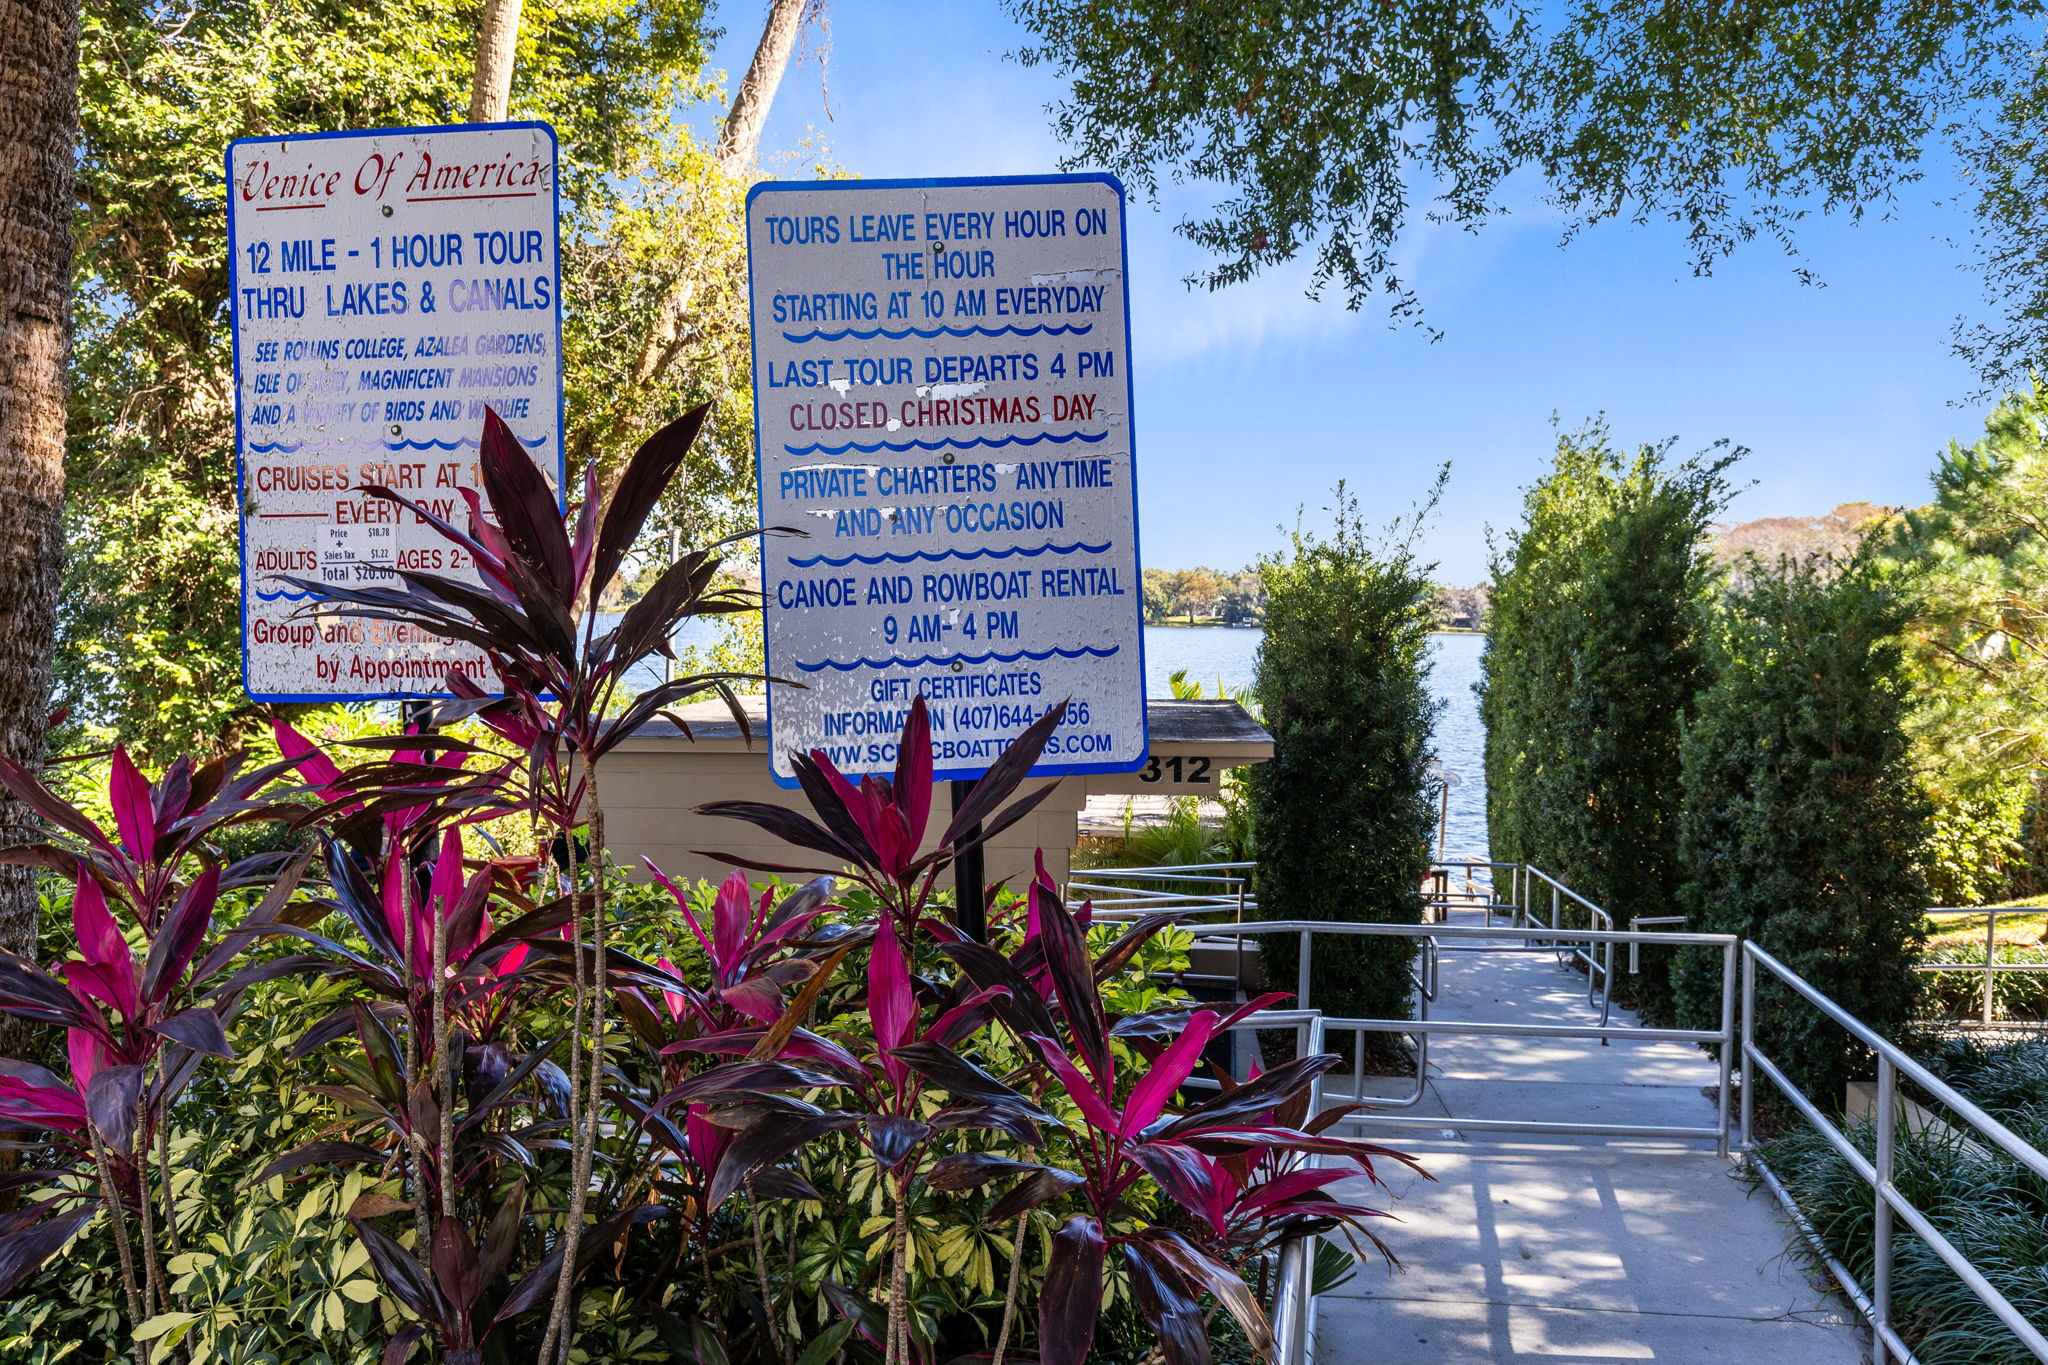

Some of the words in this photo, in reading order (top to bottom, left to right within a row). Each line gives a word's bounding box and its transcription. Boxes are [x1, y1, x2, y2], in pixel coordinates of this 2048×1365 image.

[242, 161, 340, 201] Venice
[354, 152, 403, 200] Of
[406, 152, 541, 193] America
[765, 215, 840, 245] TOURS
[850, 214, 915, 242] LEAVE
[926, 212, 995, 240] EVERY
[1005, 210, 1065, 239] HOUR
[1075, 208, 1107, 236] ON
[246, 242, 271, 274] 12
[281, 239, 336, 272] MILE
[371, 237, 381, 268] 1
[392, 234, 462, 267] HOUR
[474, 231, 543, 264] TOUR
[882, 253, 924, 280] THE
[934, 250, 996, 279] HOUR
[242, 286, 305, 319] THRU
[327, 282, 407, 316] LAKES
[420, 281, 436, 313] &
[449, 276, 550, 312] CANALS
[773, 293, 878, 323] STARTING
[887, 291, 911, 319] AT
[921, 290, 944, 318] 10
[954, 289, 987, 316] AM
[997, 286, 1105, 316] EVERYDAY
[255, 342, 278, 362] SEE
[284, 339, 339, 361] ROLLINS
[345, 337, 408, 361] COLLEGE,
[415, 336, 469, 358] AZALEA
[253, 373, 281, 394] ISLE
[286, 372, 305, 393] OF
[357, 368, 455, 391] MAGNIFICENT
[458, 365, 538, 388] MANSIONS
[768, 360, 834, 387] LAST
[844, 357, 913, 386] TOUR
[925, 353, 1039, 383] DEPARTS
[1050, 353, 1066, 378] 4
[1078, 352, 1114, 377] PM
[251, 405, 281, 425] AND
[286, 405, 296, 424] A
[360, 402, 380, 423] OF
[384, 401, 425, 422] BIRDS
[430, 400, 461, 420] AND
[467, 398, 530, 419] WDLIFE
[790, 402, 887, 431] CLOSED
[900, 396, 1040, 427] CHRISTMAS
[1053, 394, 1097, 421] DAY
[257, 464, 350, 491] CRUISES
[359, 463, 426, 490] START
[436, 463, 461, 488] AT
[780, 469, 867, 500] PRIVATE
[877, 464, 997, 496] CHARTERS
[1016, 460, 1112, 491] ANYTIME
[336, 500, 405, 524] EVERY
[415, 499, 455, 524] DAY
[835, 508, 881, 537] AND
[892, 506, 938, 535] ANY
[945, 501, 1064, 533] OCCASION
[331, 529, 347, 538] Price
[368, 528, 390, 537] $18.78
[255, 551, 317, 570] ADULTS
[397, 550, 442, 569] AGES
[324, 551, 343, 559] Sales
[344, 551, 355, 559] Tax
[371, 550, 388, 558] $1.22
[322, 566, 349, 581] Total
[356, 566, 394, 582] $20.00
[778, 578, 856, 609] CANOE
[867, 576, 913, 605] AND
[923, 571, 1032, 603] ROWBOAT
[1041, 567, 1125, 598] RENTAL
[253, 619, 314, 648] Group
[324, 617, 362, 643] and
[884, 616, 897, 644] 9
[962, 613, 976, 640] 4
[987, 611, 1019, 639] PM
[317, 656, 339, 683] by
[349, 655, 487, 683] Appointment
[871, 678, 911, 702] GIFT
[919, 672, 1041, 699] CERTIFICATES
[824, 709, 945, 736] INFORMAN
[1138, 757, 1211, 783] 312
